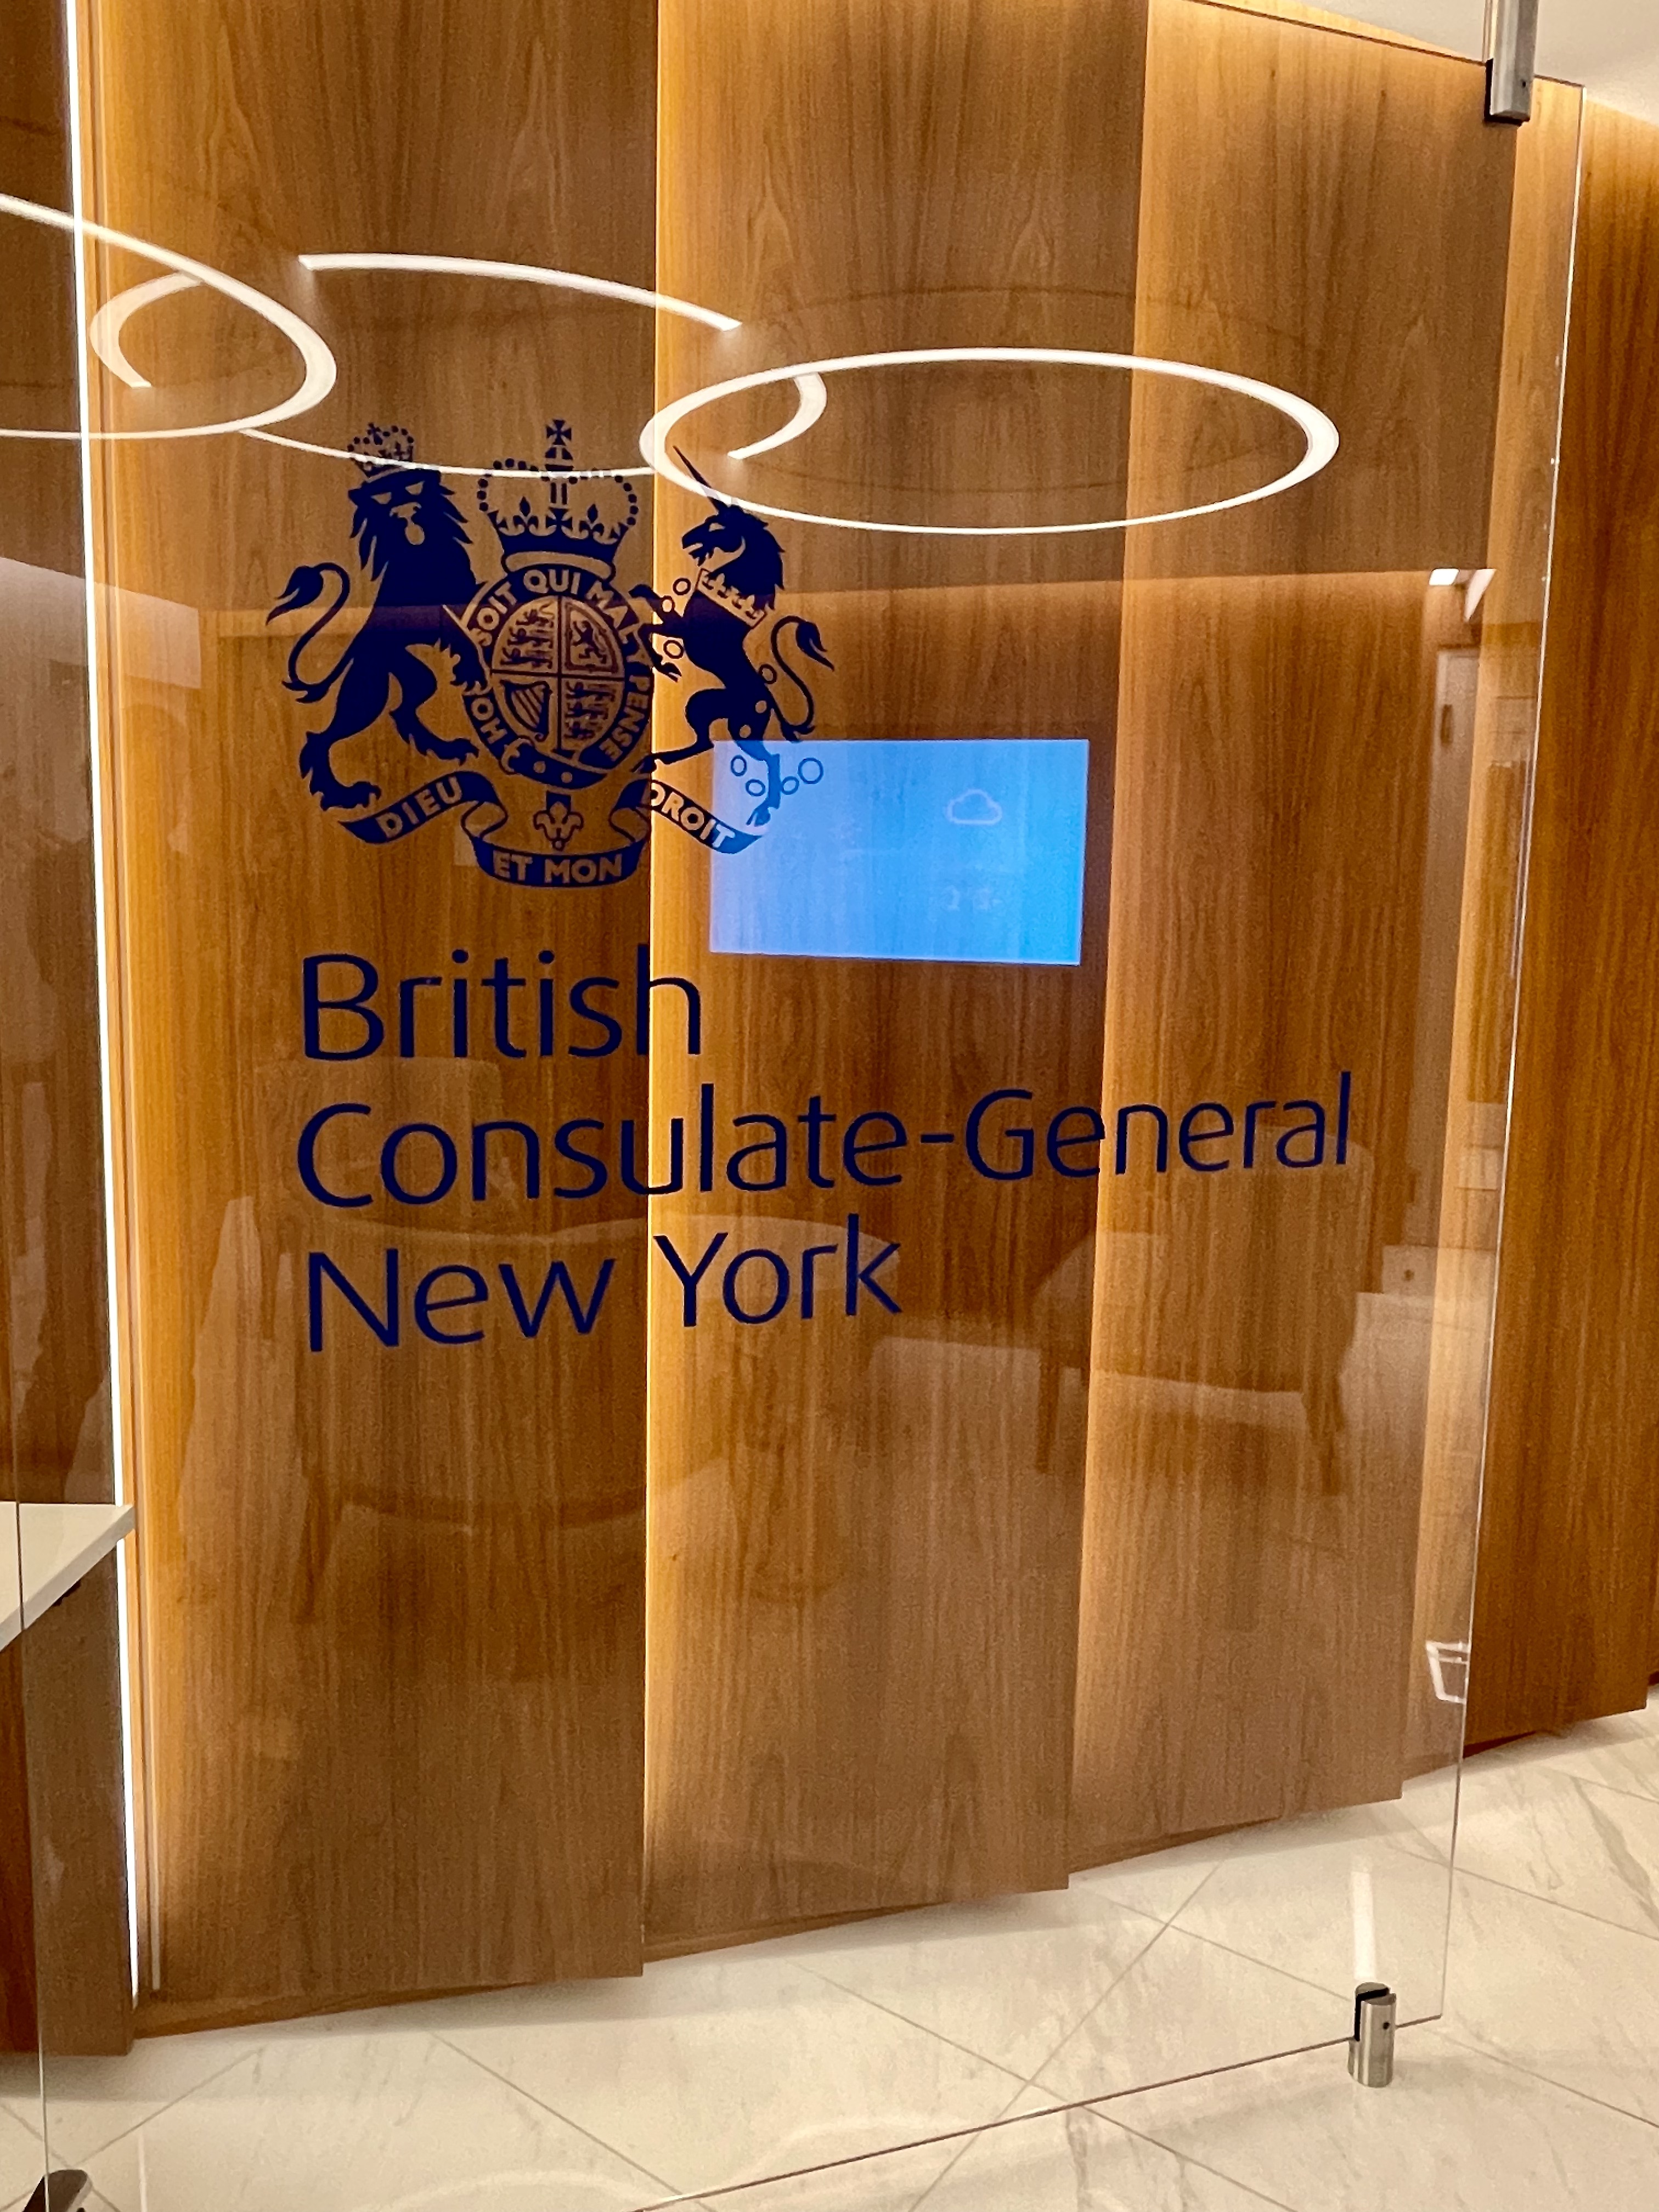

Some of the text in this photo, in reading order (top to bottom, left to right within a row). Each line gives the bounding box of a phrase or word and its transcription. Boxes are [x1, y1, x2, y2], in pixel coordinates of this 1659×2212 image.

[523, 568, 580, 594] QUI
[586, 582, 638, 644] MAL
[470, 582, 517, 646] SOIT
[599, 675, 650, 761] PENSE
[375, 776, 463, 838] DIEU
[641, 782, 735, 848] DROIT
[493, 856, 622, 882] ET MON
[303, 943, 701, 1061] British
[297, 1073, 1351, 1207] Consulate-General
[308, 1215, 901, 1351] New York
